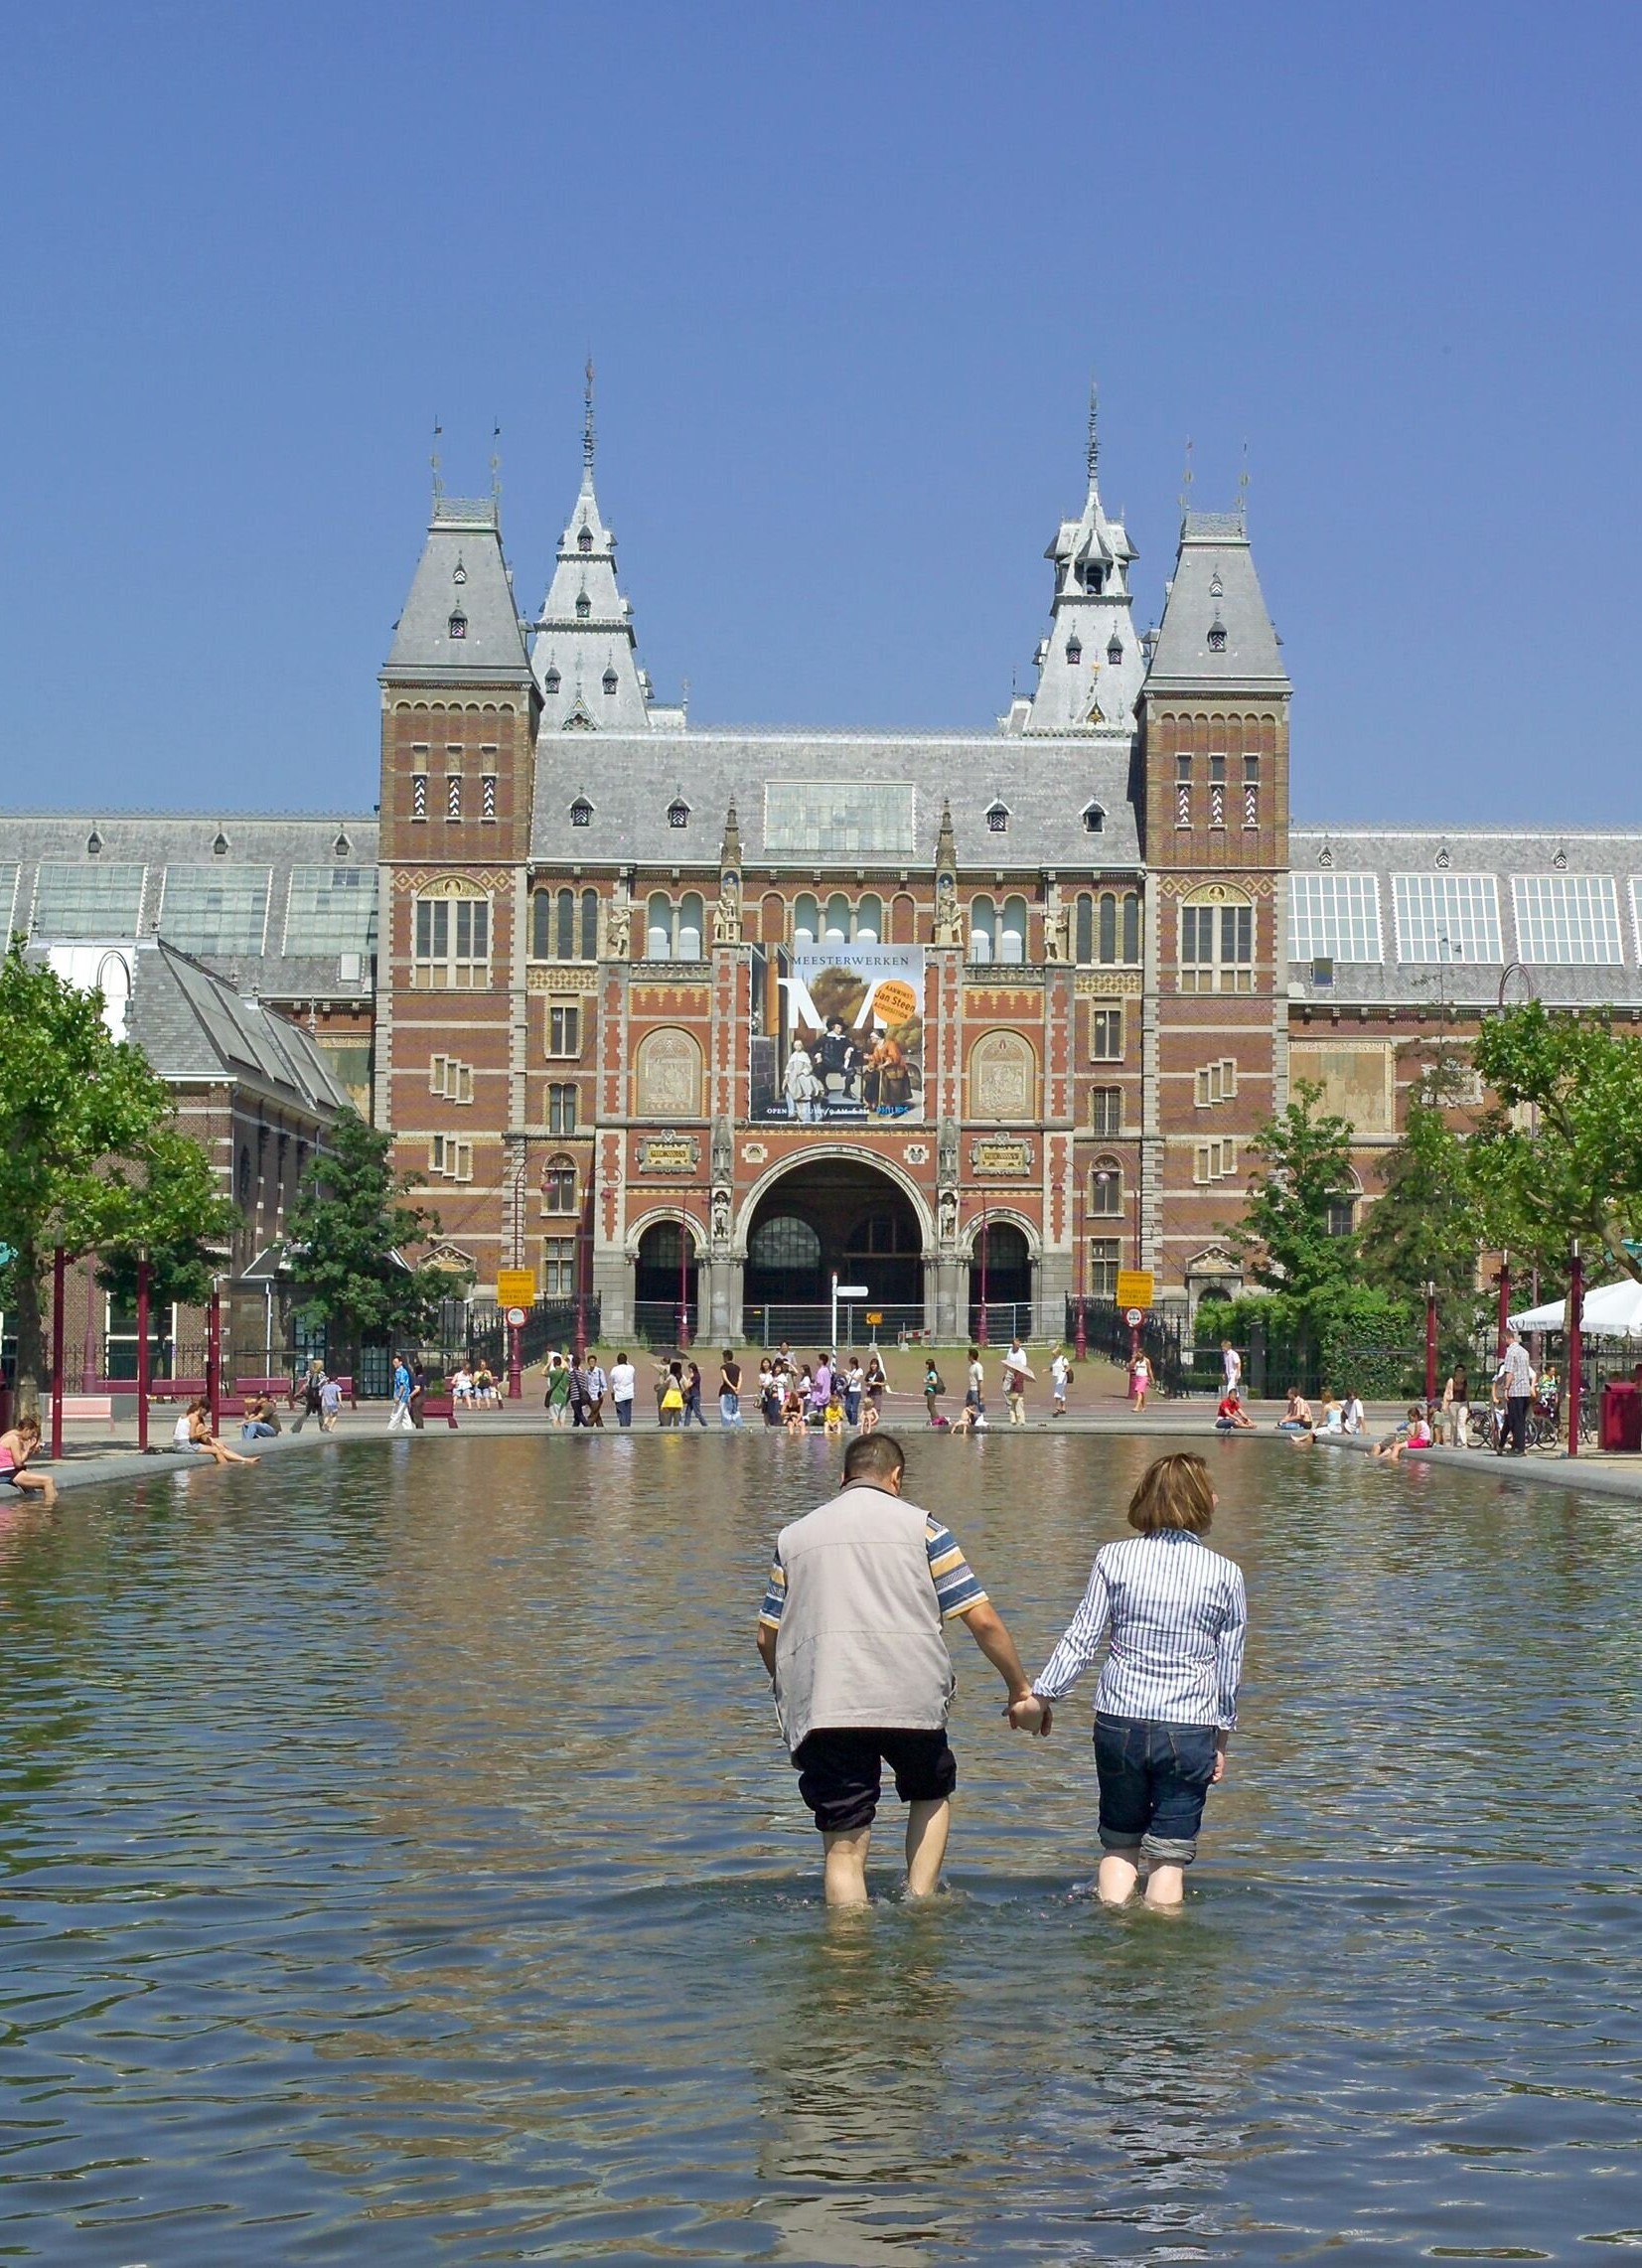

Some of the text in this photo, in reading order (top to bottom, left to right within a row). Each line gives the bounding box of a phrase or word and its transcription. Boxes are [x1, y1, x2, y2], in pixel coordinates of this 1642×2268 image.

[792, 956, 909, 966] MEESTERWERKEN
[884, 984, 913, 1000] AANWINST
[874, 989, 916, 1013] Jan Steen
